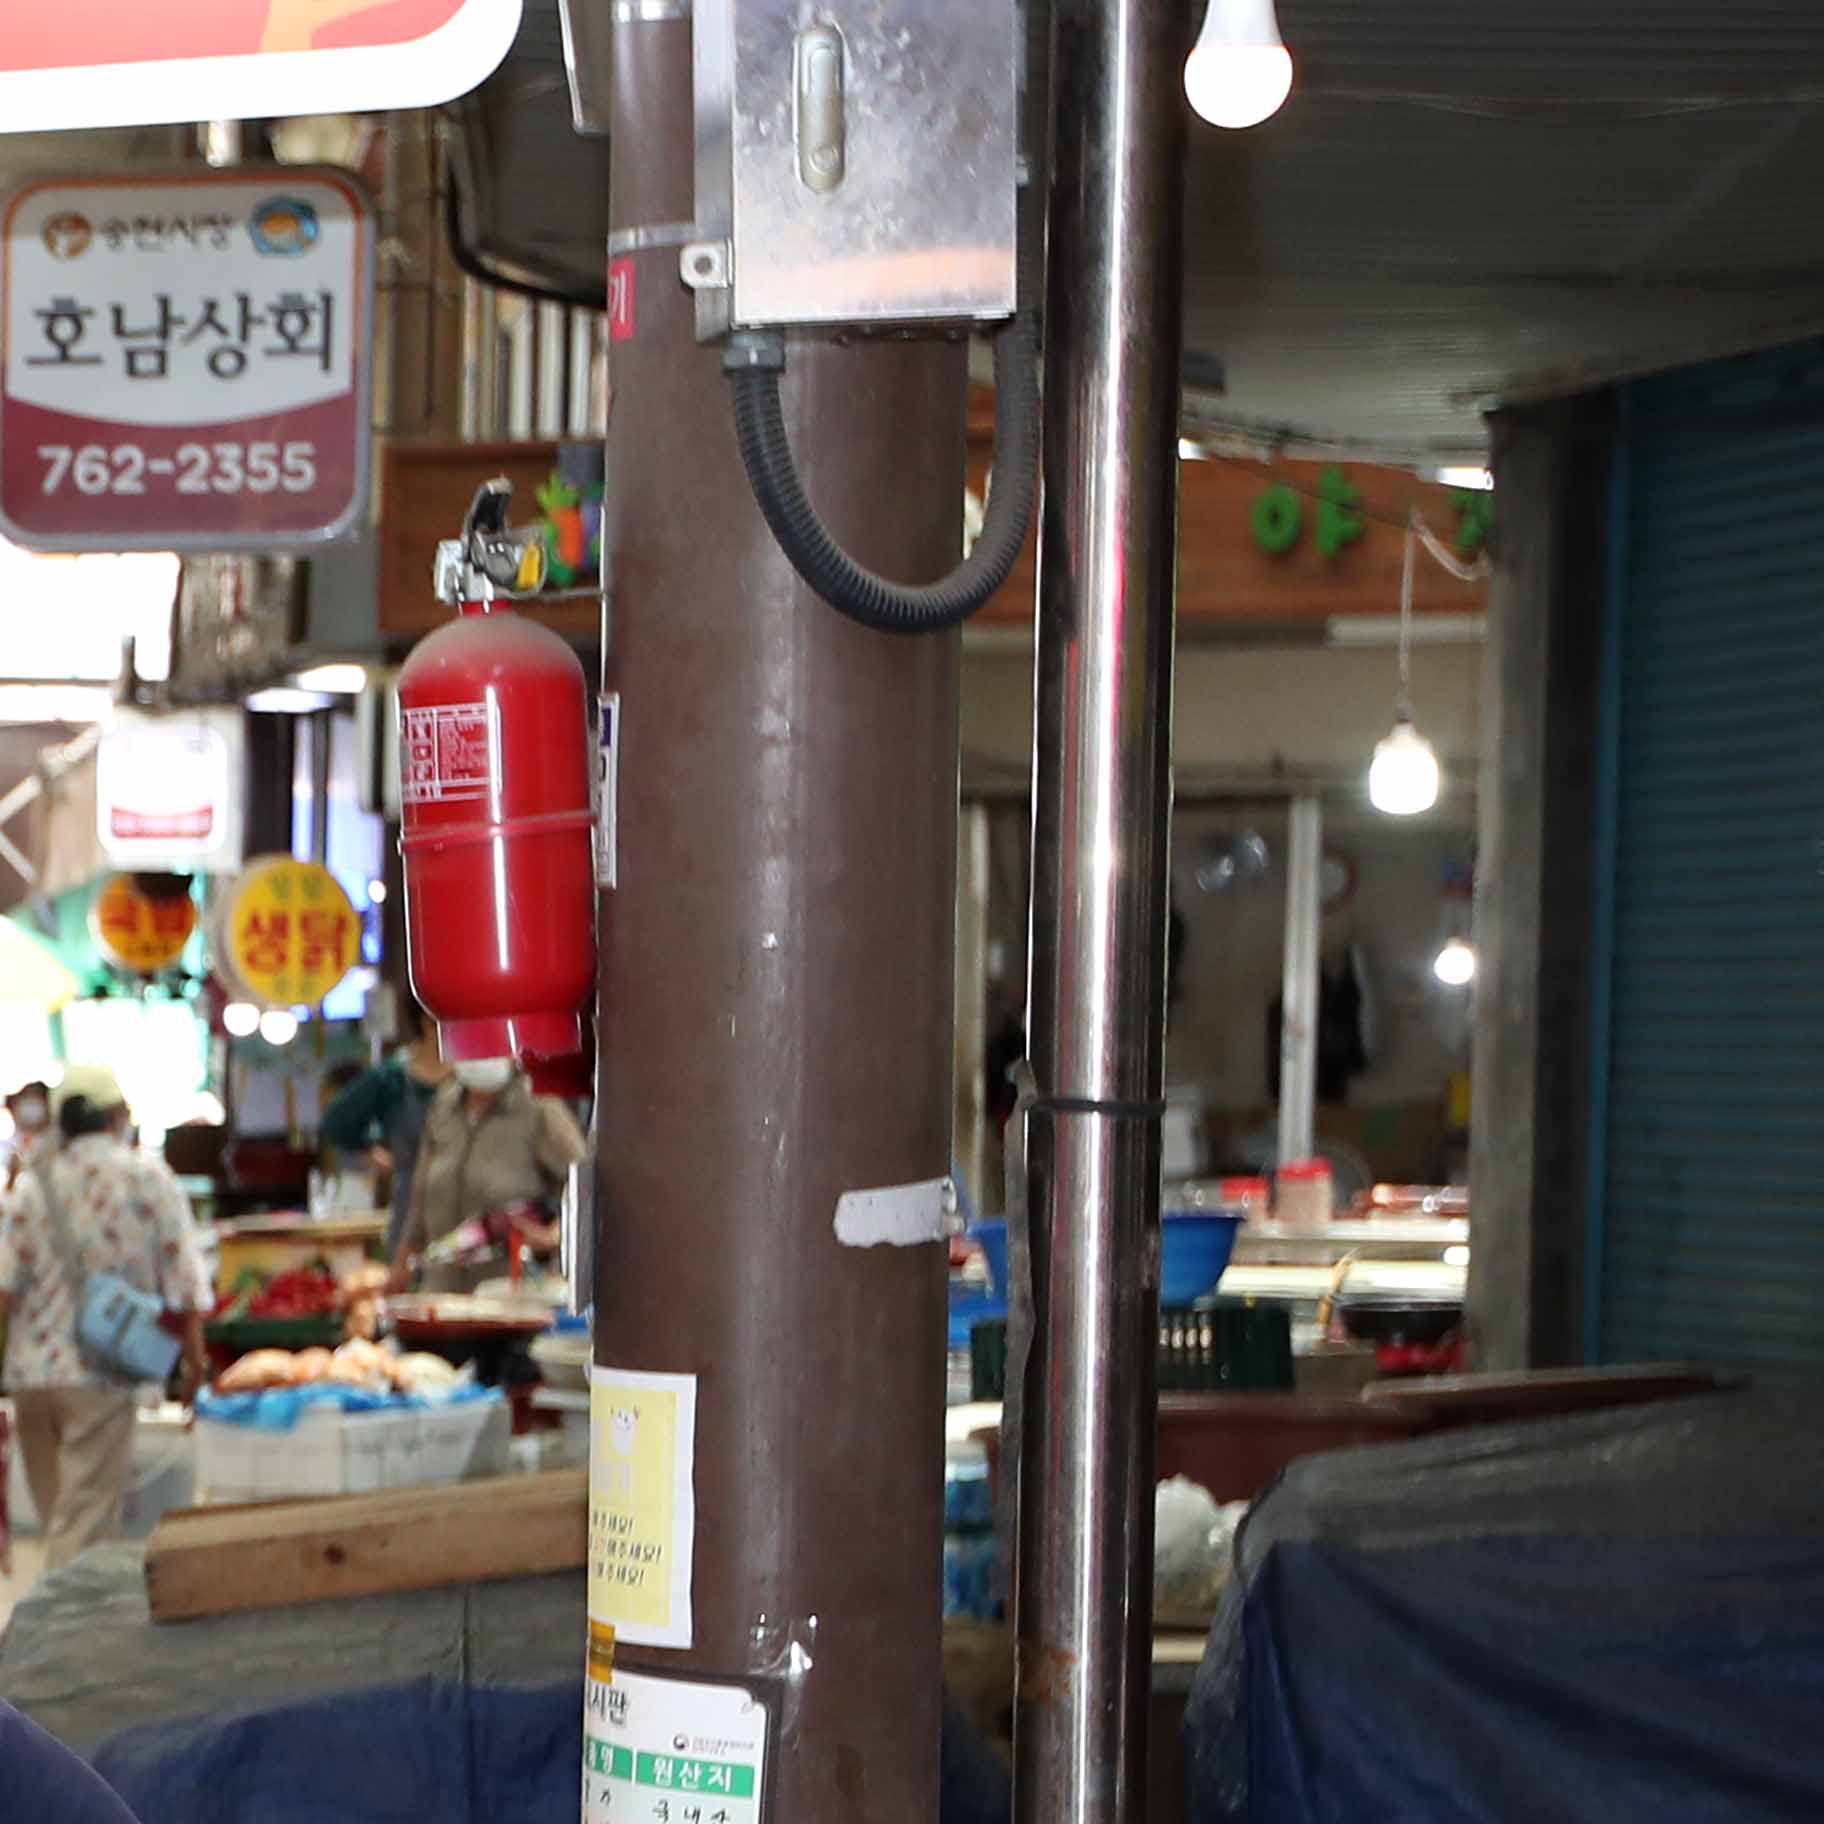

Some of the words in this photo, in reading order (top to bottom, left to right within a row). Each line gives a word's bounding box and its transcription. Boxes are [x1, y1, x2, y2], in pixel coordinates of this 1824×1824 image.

[102, 212, 234, 253] 송현시장
[24, 291, 336, 381] 호남상회
[37, 441, 317, 495] 762-2355
[653, 1755, 734, 1794] 원산지
